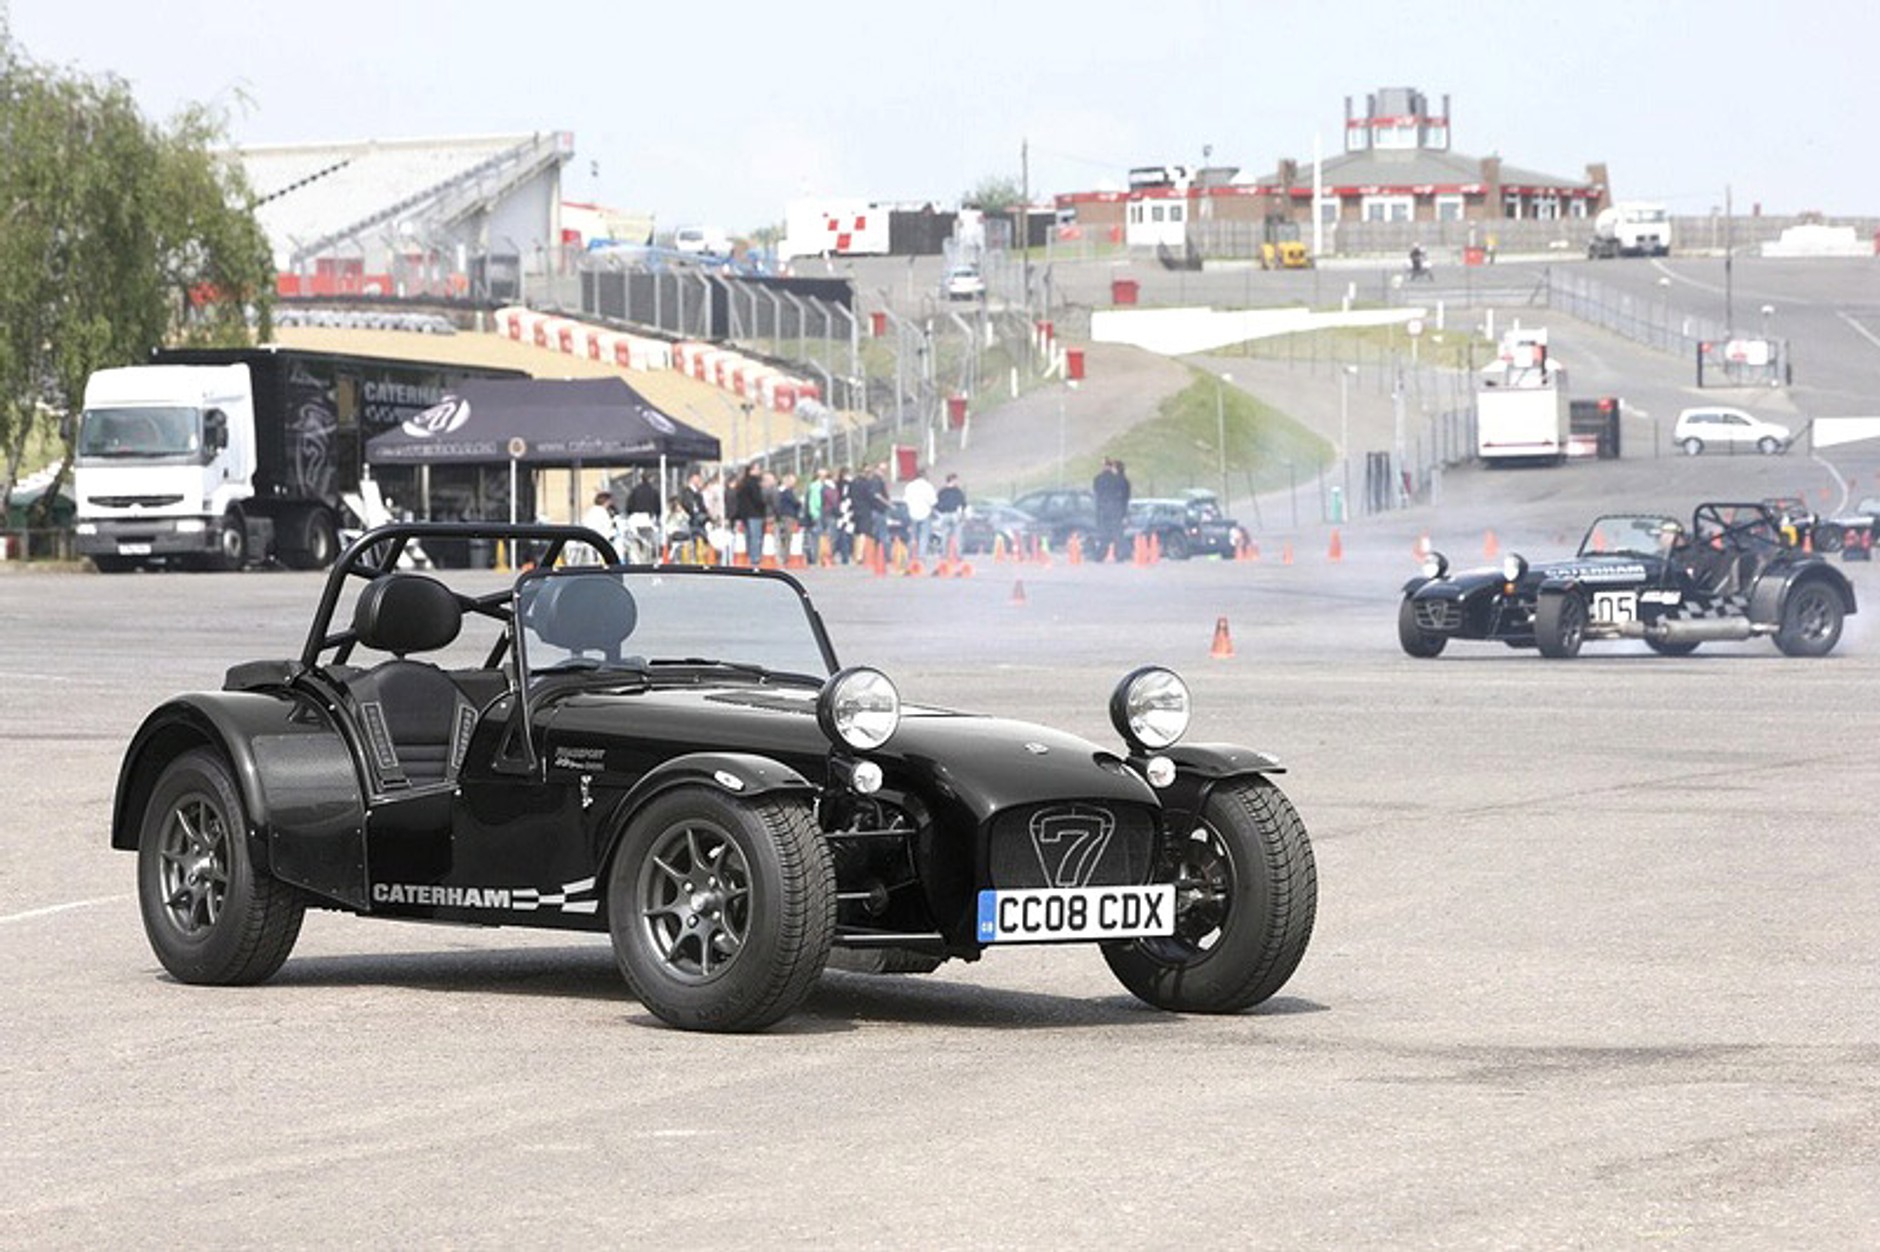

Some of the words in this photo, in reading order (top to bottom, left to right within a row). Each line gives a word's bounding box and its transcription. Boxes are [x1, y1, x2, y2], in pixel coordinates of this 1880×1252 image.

[364, 382, 442, 404] CATERHA
[1040, 815, 1104, 887] 7
[373, 883, 511, 908] CATERHAM
[1000, 894, 1088, 934] CC08
[1099, 892, 1164, 930] CDX
